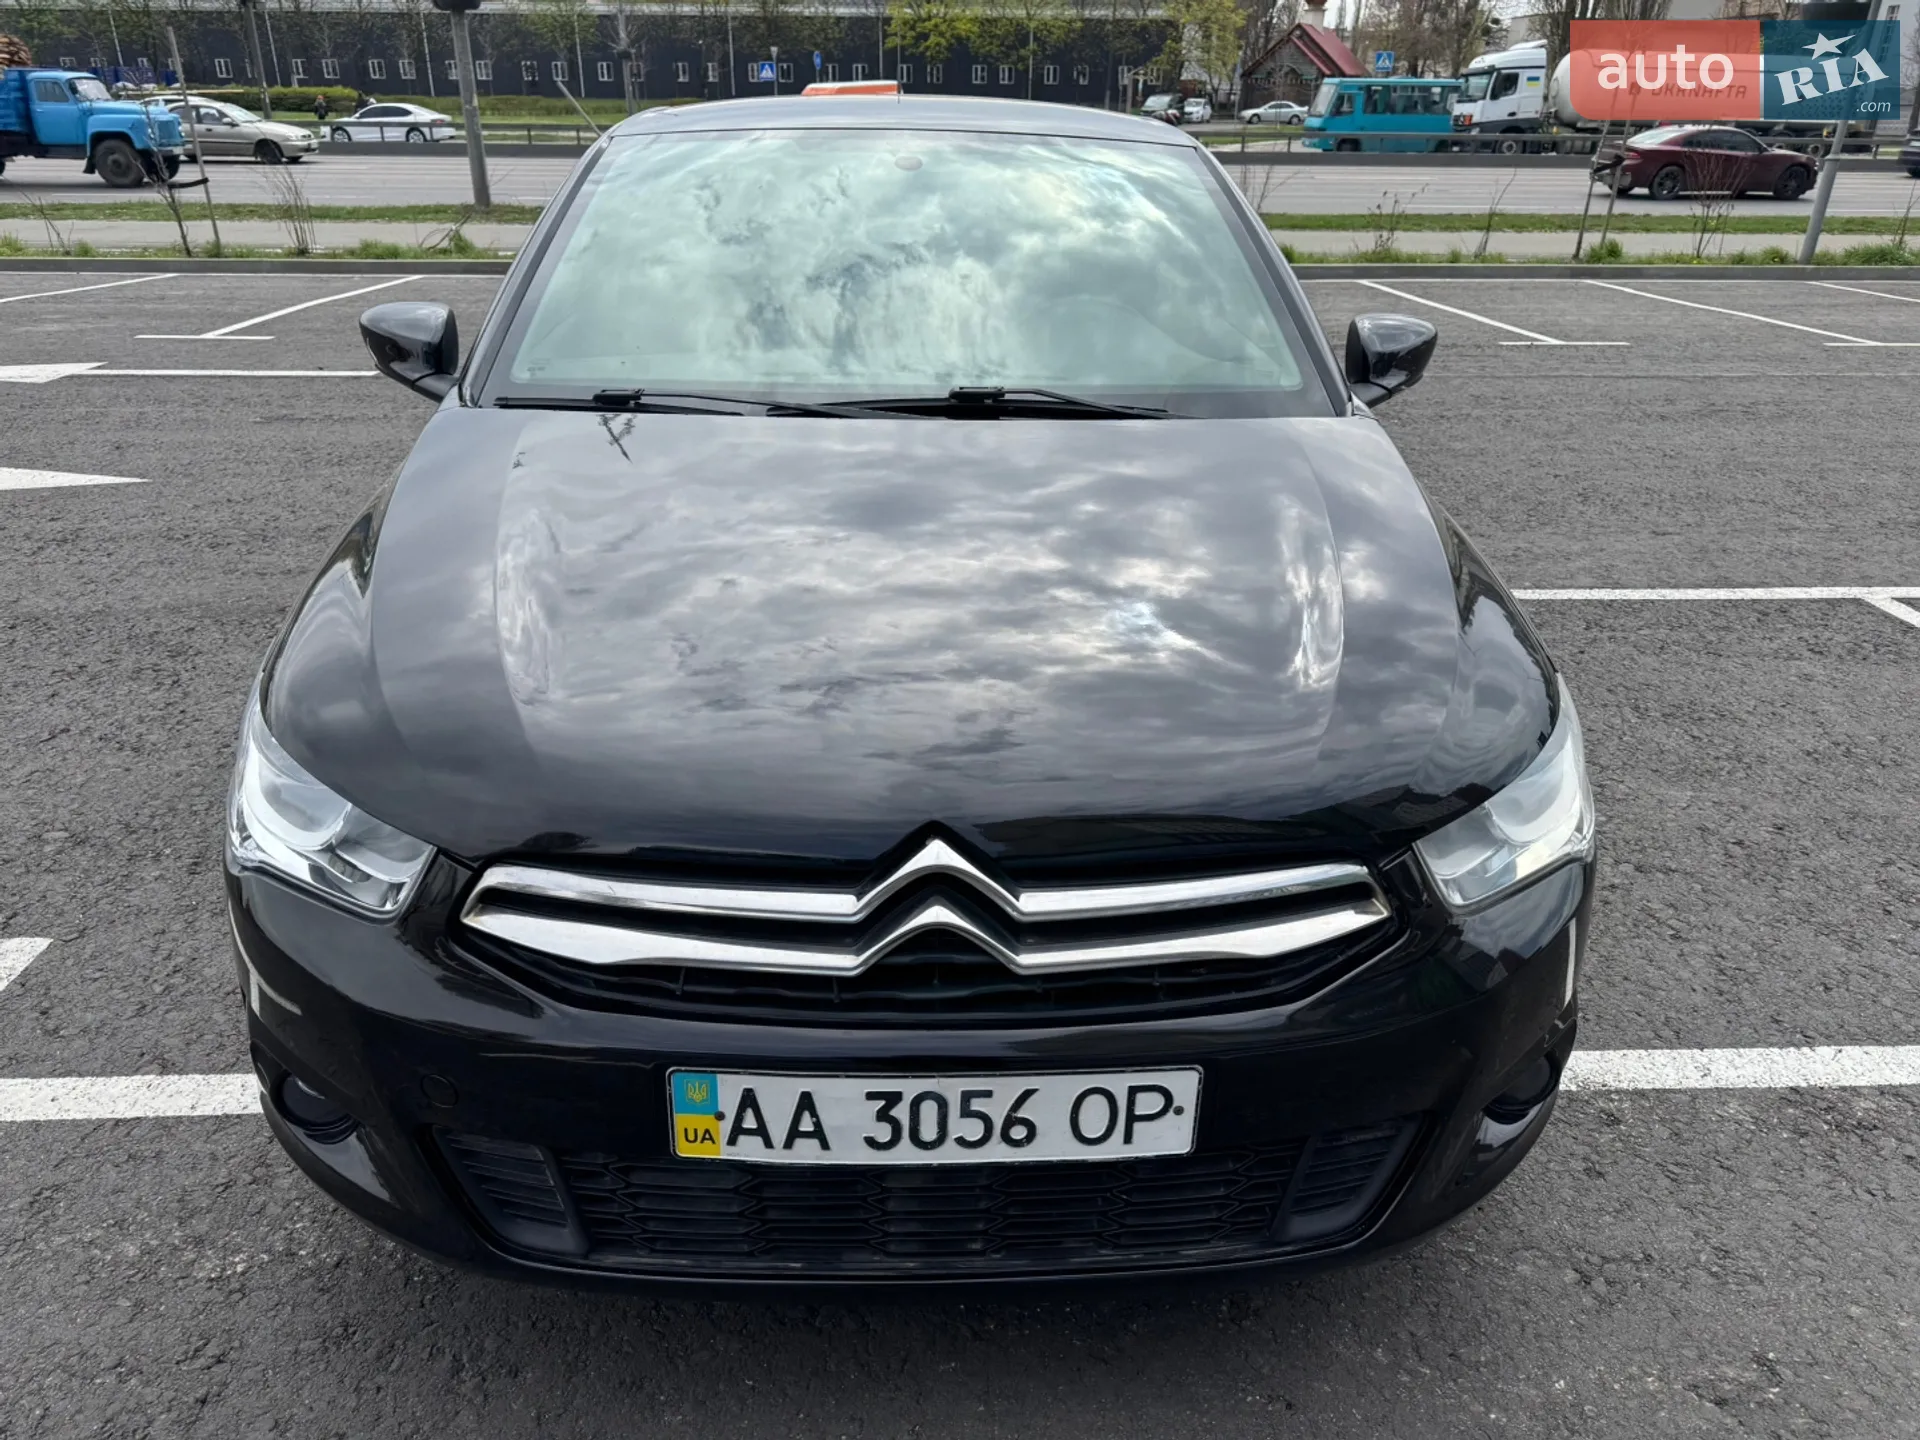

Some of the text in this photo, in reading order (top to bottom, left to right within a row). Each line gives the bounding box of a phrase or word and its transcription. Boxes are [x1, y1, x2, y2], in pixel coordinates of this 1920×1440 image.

[684, 1127, 716, 1145] UA
[726, 1084, 1175, 1151] AA 3056 OP
